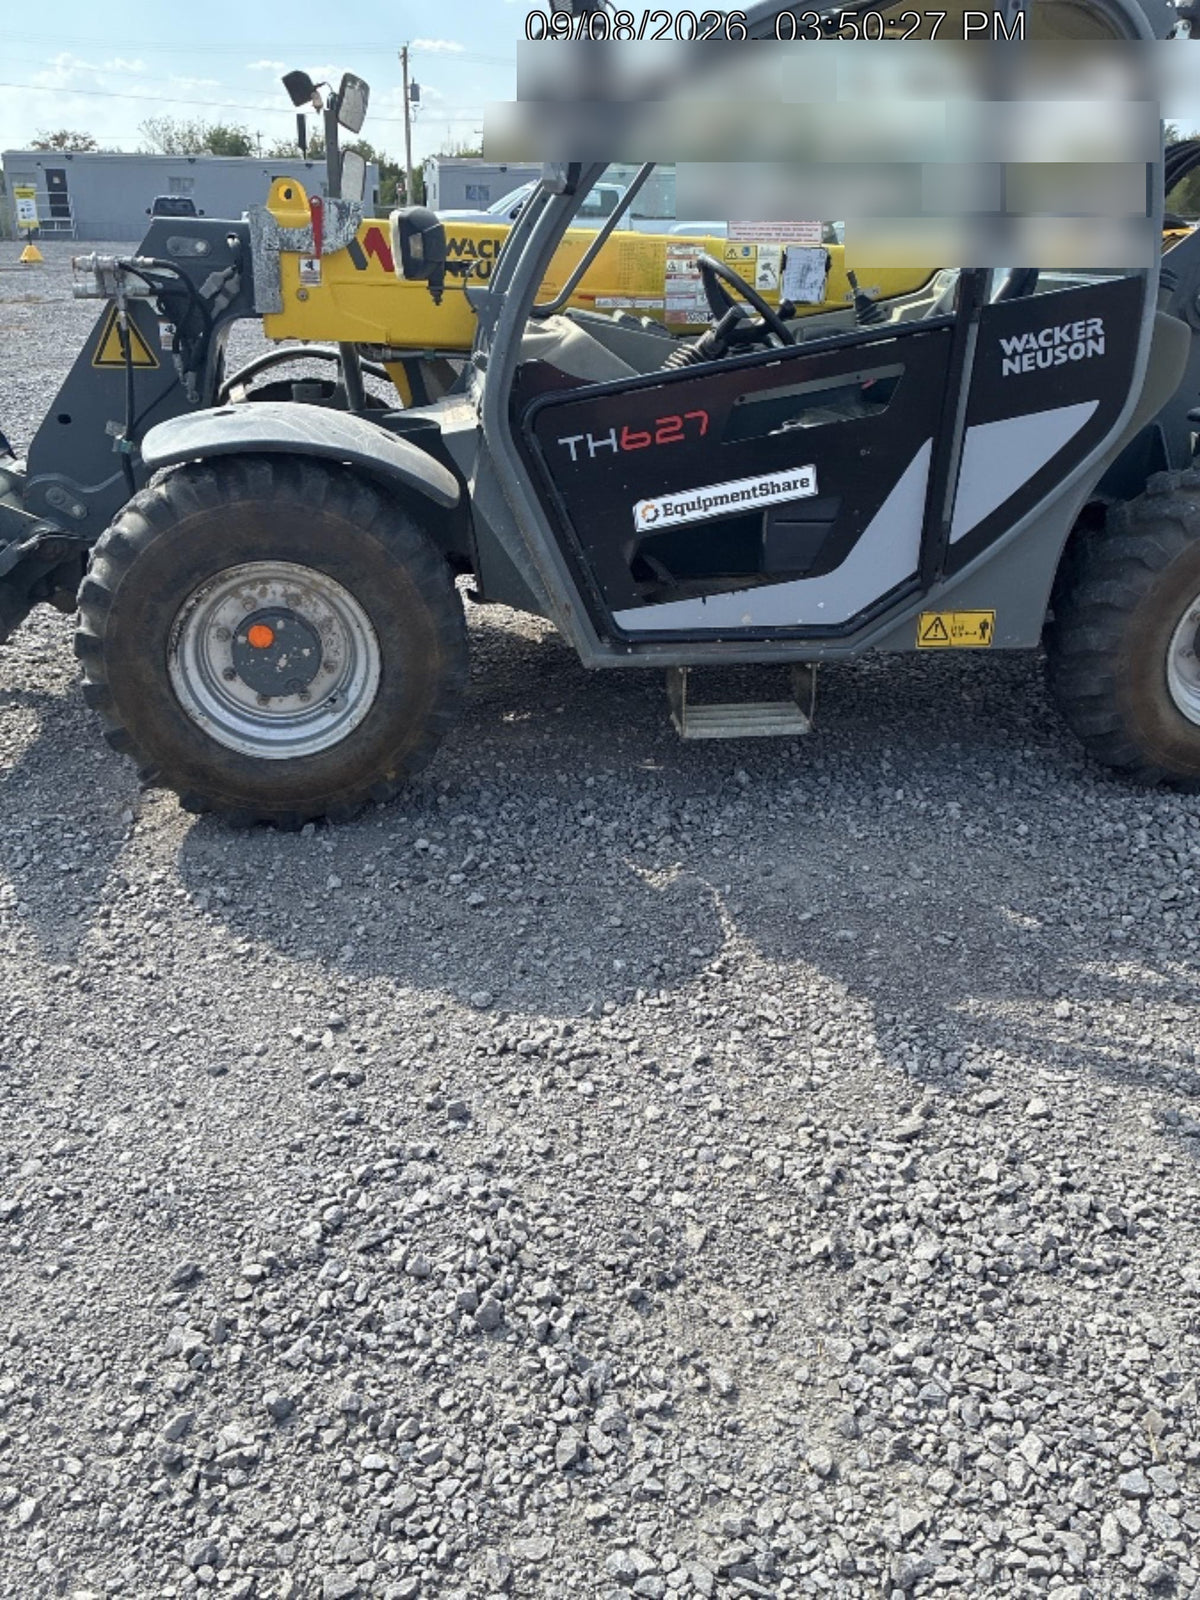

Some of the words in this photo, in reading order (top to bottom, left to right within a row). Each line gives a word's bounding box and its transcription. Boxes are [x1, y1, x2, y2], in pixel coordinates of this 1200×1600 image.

[999, 318, 1105, 356] WACKER
[1002, 336, 1105, 377] NEUSON
[558, 410, 709, 461] TH627
[662, 477, 810, 519] EquipmentShare
